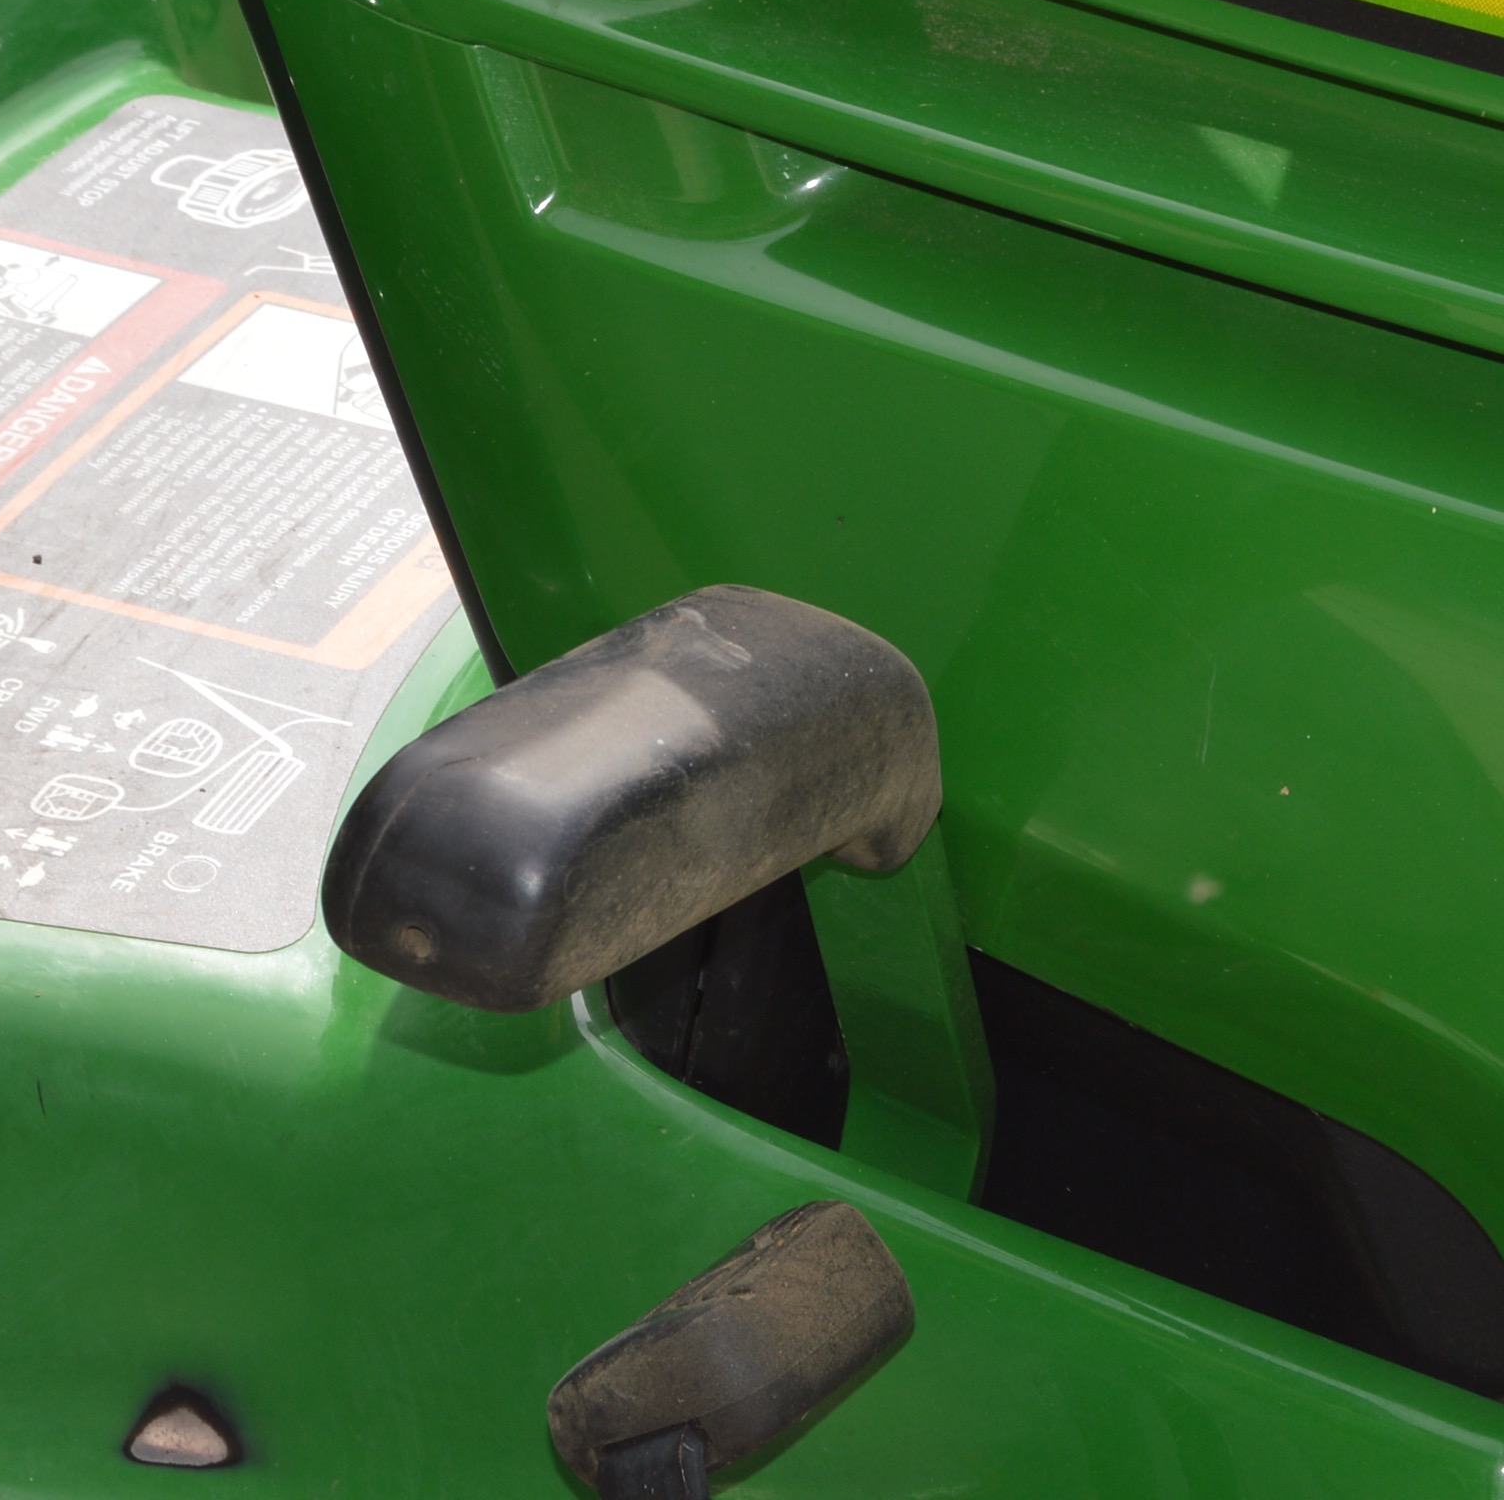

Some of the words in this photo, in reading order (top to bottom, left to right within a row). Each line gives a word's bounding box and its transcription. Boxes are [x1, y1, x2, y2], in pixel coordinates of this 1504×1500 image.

[164, 118, 202, 142] LIFT
[111, 138, 171, 180] ADJUST
[77, 178, 120, 207] STOP
[0, 358, 36, 384] ARMS
[25, 340, 82, 383] ROTATING
[110, 412, 163, 451] Remove
[154, 417, 183, 435] Set
[168, 422, 203, 445] Stop
[204, 409, 244, 436] When
[226, 413, 264, 439] Read
[258, 417, 284, 431] by
[294, 427, 320, 447] and
[129, 433, 160, 457] park
[161, 436, 212, 472] leaving
[241, 431, 267, 448] the
[253, 422, 304, 460] Remove
[308, 432, 344, 457] Keep
[331, 436, 361, 459] stop
[367, 441, 385, 451] If
[87, 451, 118, 470] key
[97, 457, 137, 487] brake
[130, 445, 174, 479] engine
[205, 448, 250, 482] blades
[241, 446, 299, 493] switches)
[274, 457, 313, 486] safety
[322, 450, 372, 491] machine
[366, 446, 399, 473] Avoid
[215, 460, 258, 494] objects
[295, 459, 340, 492] blades
[374, 476, 395, 490] up
[193, 495, 224, 515] that
[231, 493, 249, 504] in
[235, 486, 281, 523] devices
[274, 492, 300, 513] and
[291, 491, 327, 520] stops
[326, 474, 371, 511] sudden
[354, 489, 381, 509] and
[131, 488, 177, 527] manual
[200, 503, 236, 533] place
[326, 508, 361, 535] down
[378, 507, 407, 526] OR
[164, 515, 199, 544] could
[246, 512, 282, 538] back
[256, 519, 296, 549] going
[296, 512, 333, 539] turns
[373, 510, 431, 564] SERIOUS
[149, 543, 173, 557] be
[178, 532, 206, 554] and
[216, 538, 252, 567] down
[336, 526, 388, 567] DEATH
[110, 557, 157, 593] thrown
[131, 554, 183, 596] working
[179, 567, 222, 601] slowly
[271, 570, 295, 590] not
[323, 565, 376, 610] INJURY
[235, 589, 276, 624] across
[14, 695, 62, 734] FWD
[109, 830, 180, 894] BRAKE
